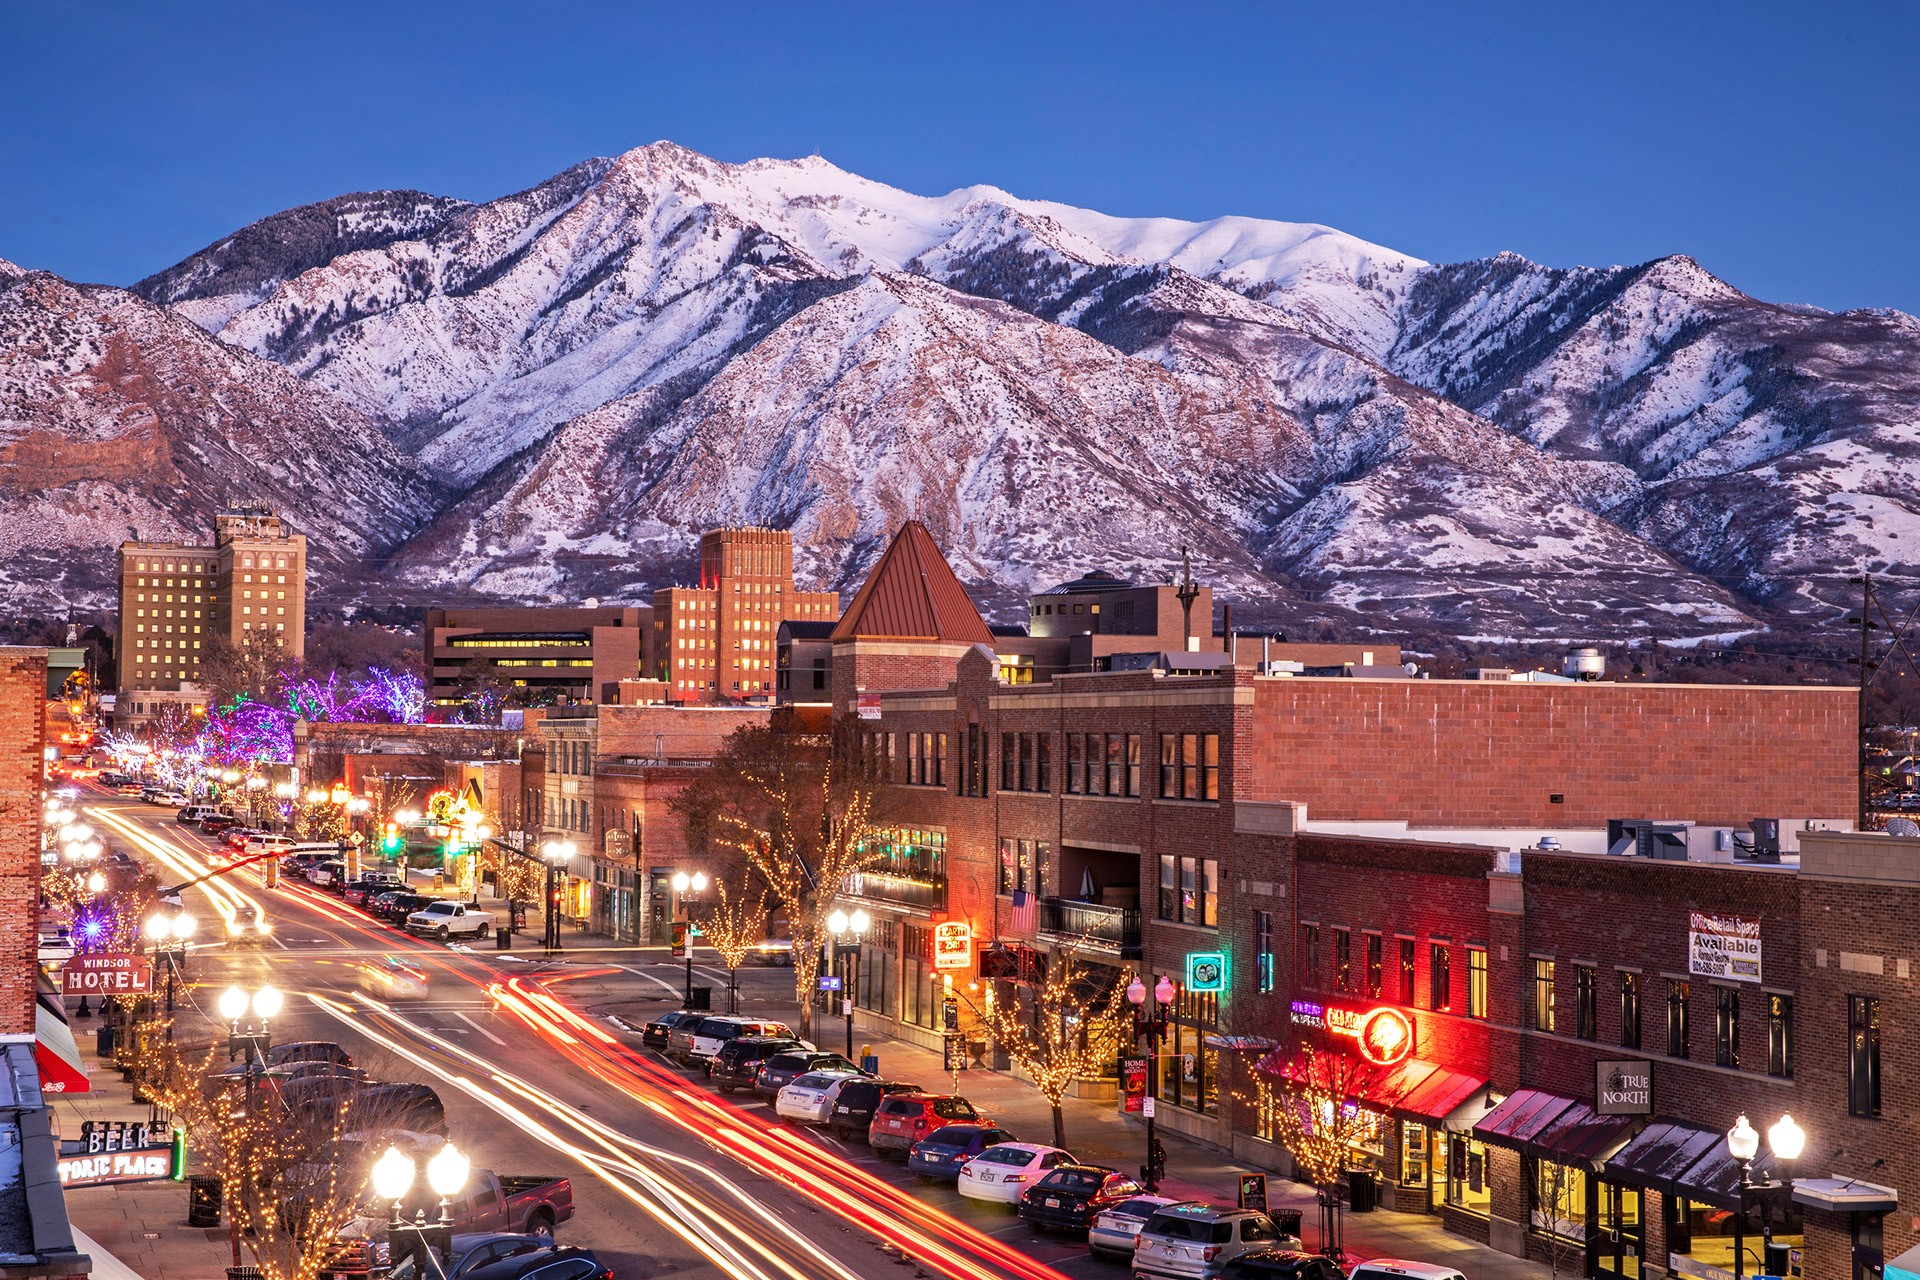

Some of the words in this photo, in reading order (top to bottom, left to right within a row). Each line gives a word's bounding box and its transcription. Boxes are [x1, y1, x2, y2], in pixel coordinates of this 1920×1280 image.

[1736, 917, 1760, 937] Space
[1693, 934, 1758, 954] Available
[83, 958, 131, 968] WINDSOR
[68, 971, 146, 989] HOTEL
[1620, 1075, 1649, 1088] TRUE
[1603, 1091, 1649, 1104] NORTH
[88, 1127, 150, 1153] BEER
[113, 1155, 167, 1175] PLACE
